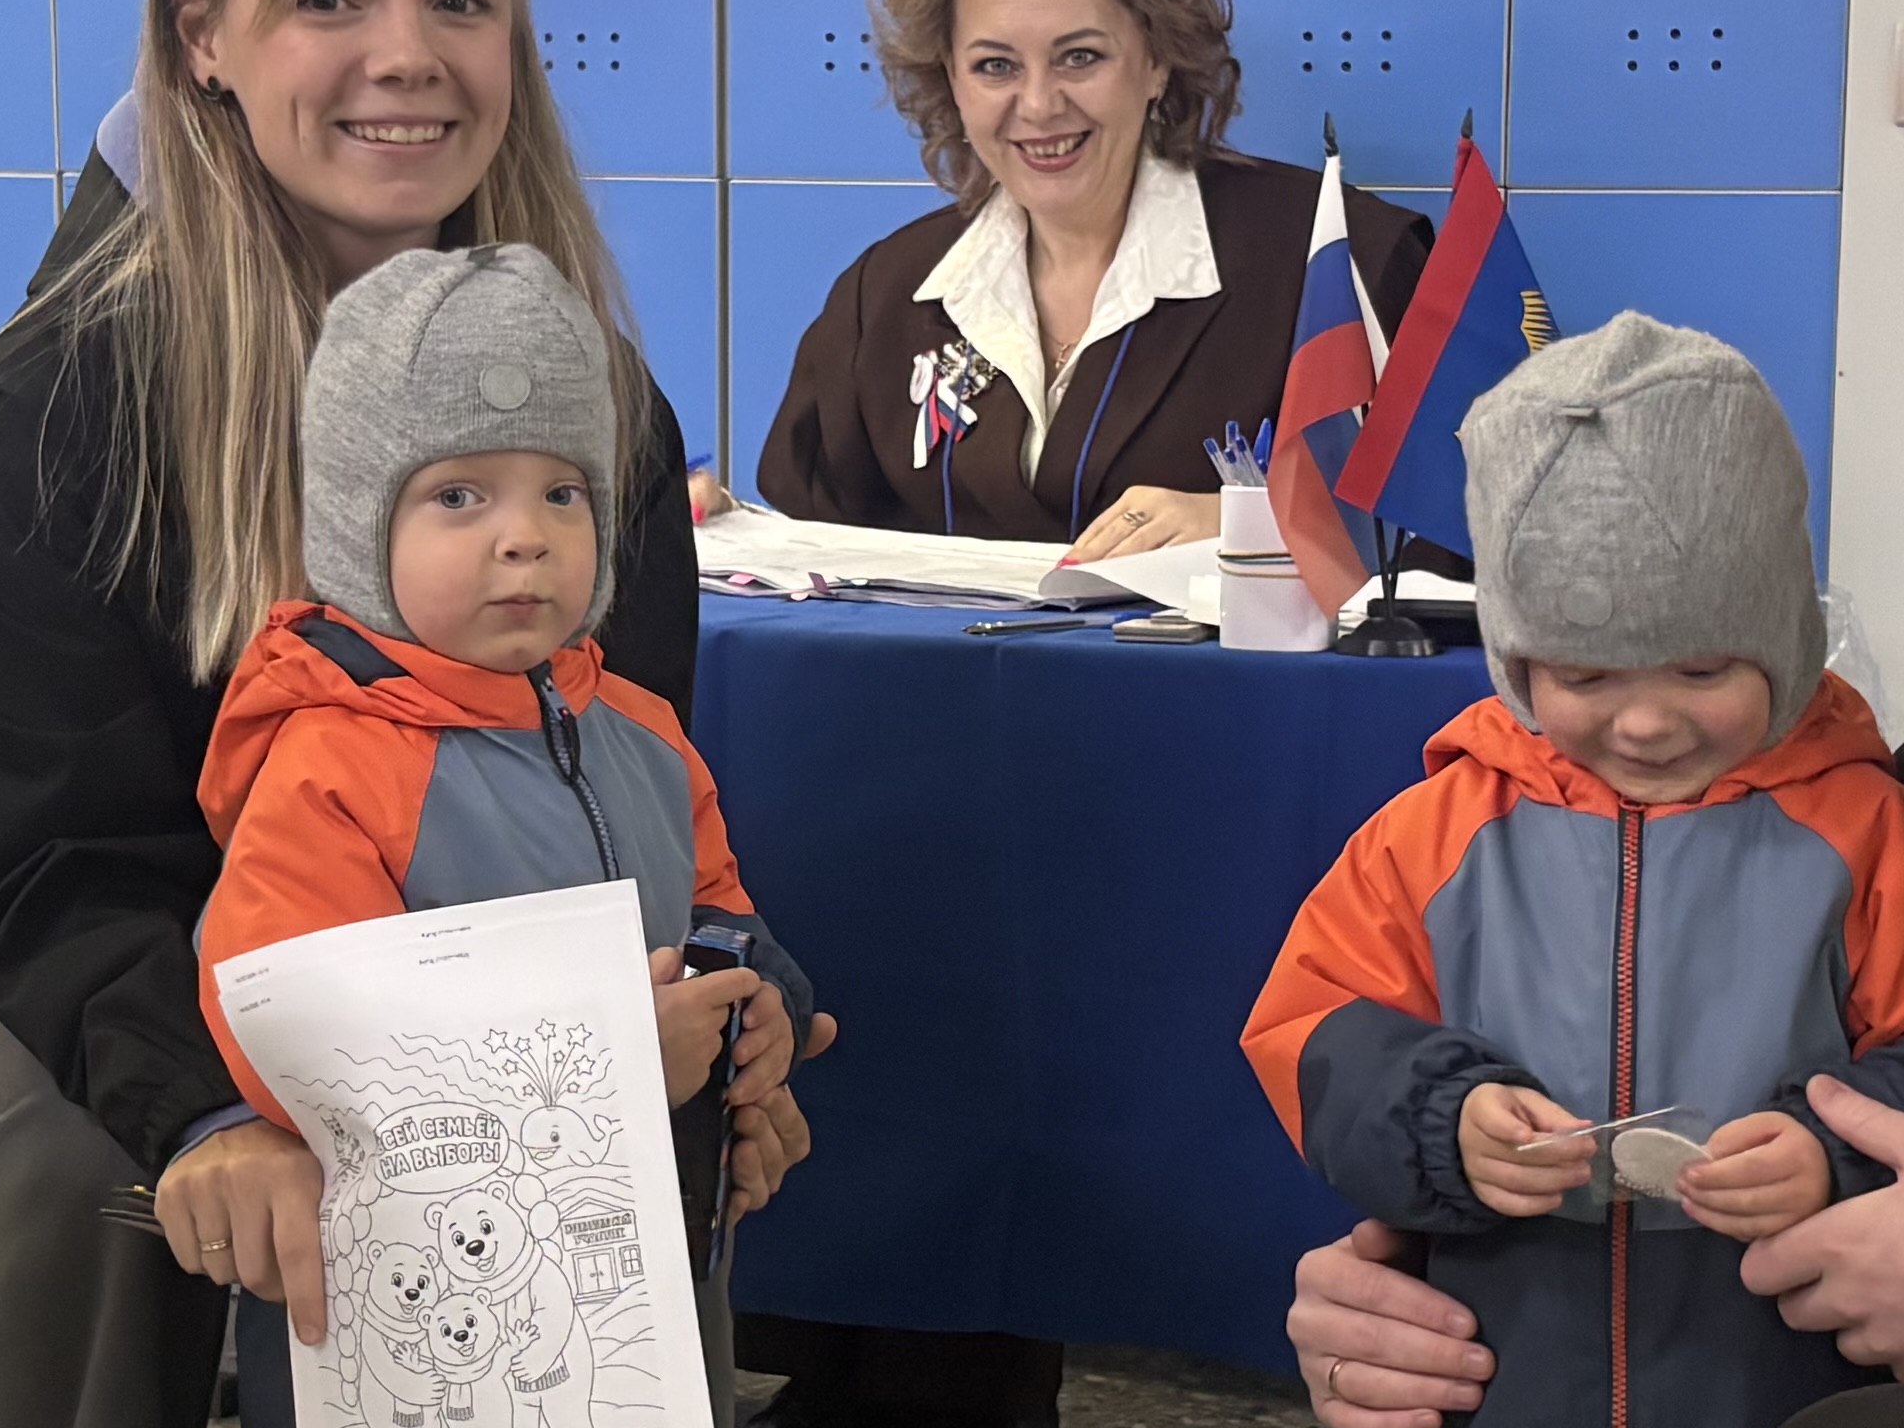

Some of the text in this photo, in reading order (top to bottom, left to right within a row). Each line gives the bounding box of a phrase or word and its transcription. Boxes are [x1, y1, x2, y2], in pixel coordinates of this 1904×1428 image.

[377, 1116, 420, 1152] СЕЙ
[379, 1142, 501, 1180] НА ВЫБОРЫ
